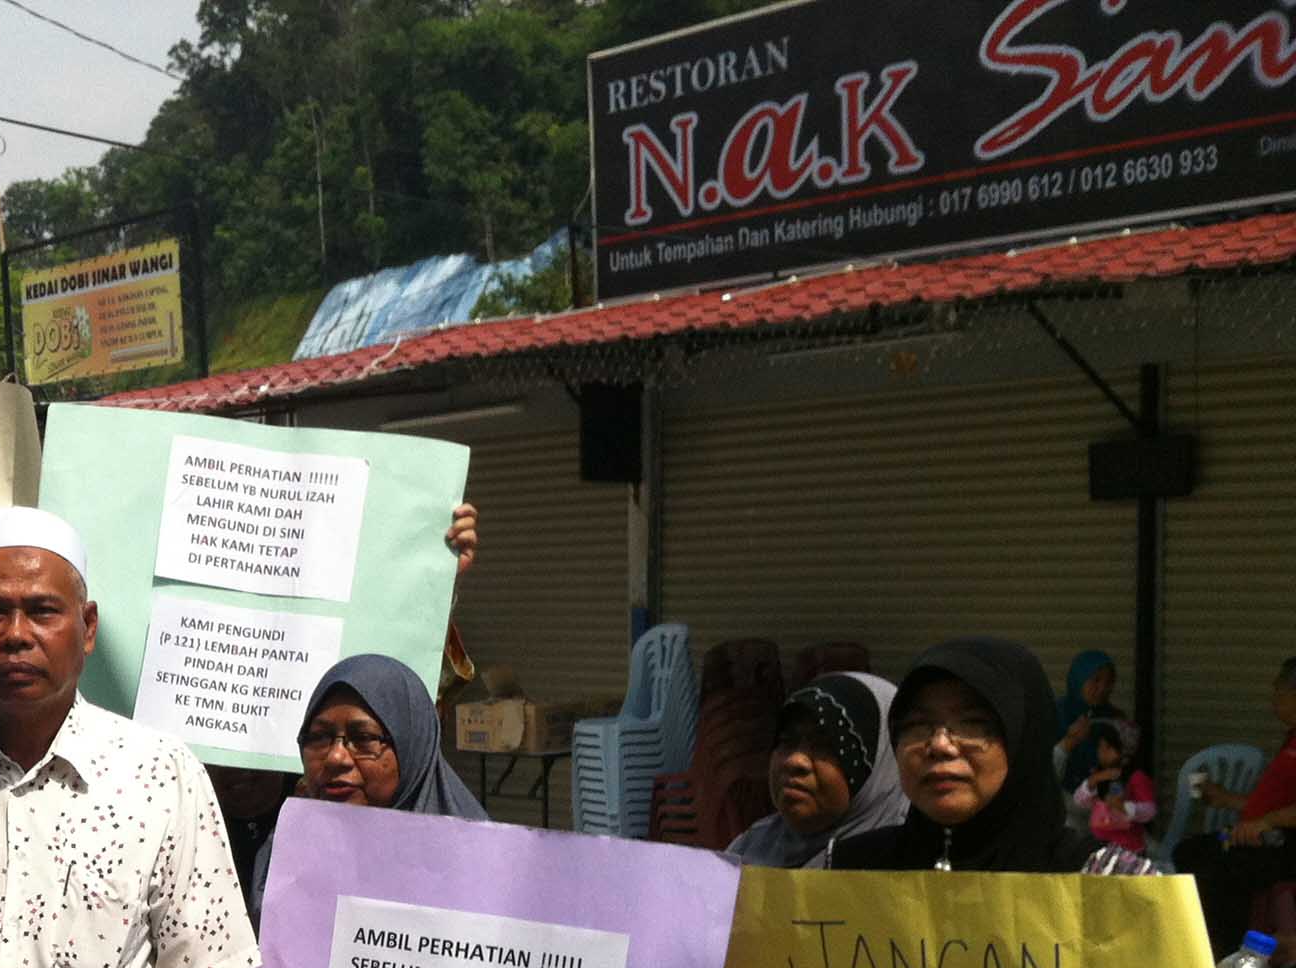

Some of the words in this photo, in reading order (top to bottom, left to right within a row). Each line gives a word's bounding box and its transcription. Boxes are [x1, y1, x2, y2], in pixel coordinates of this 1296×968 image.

[607, 37, 790, 113] RESTORAN
[609, 244, 652, 271] Untuk
[657, 230, 733, 264] Tempahan
[738, 225, 770, 249] Dan
[774, 212, 844, 244] Katering
[849, 196, 923, 227] Hubungi
[939, 188, 971, 215] 017
[1028, 172, 1063, 194] 612
[1068, 168, 1077, 193] /
[1080, 164, 1118, 190] 012
[1123, 154, 1173, 183] 6630
[1179, 145, 1218, 176] 933
[26, 282, 58, 300] KEDAI
[61, 274, 89, 292] DOBI
[129, 254, 172, 275] WANGI
[184, 455, 226, 472] AMBIL
[230, 463, 301, 482] PERHATIAN
[182, 474, 238, 492] SEBELUM
[242, 482, 256, 496] YB
[260, 488, 303, 501] NURUL
[306, 492, 335, 503] IZAH
[197, 496, 233, 511] LAHIR
[237, 503, 270, 518] KAMI
[274, 508, 302, 520] DAH
[187, 513, 258, 535] MENGUNDI
[263, 523, 276, 537] DI
[279, 527, 304, 539] SINI
[191, 533, 217, 547] HAK
[221, 538, 254, 554] KAMI
[259, 544, 297, 558] TETAP
[188, 552, 201, 564] DI
[205, 555, 300, 577] PERTAHANKAN
[180, 617, 213, 632] KAMI
[217, 623, 284, 641] PENGUNDI
[204, 640, 258, 658] LEMBAH
[262, 648, 308, 663] PANTAI
[184, 657, 233, 674] PINDAH
[237, 665, 268, 678] DARI
[155, 671, 227, 692] SETINGGAN
[231, 684, 248, 696] KG
[253, 686, 302, 701] KERINCI
[175, 694, 189, 706] KE
[232, 704, 270, 717] BUKIT
[185, 715, 248, 734] ANGKASA
[353, 928, 411, 950] AMBIL
[418, 936, 530, 968] PERHATIAN
